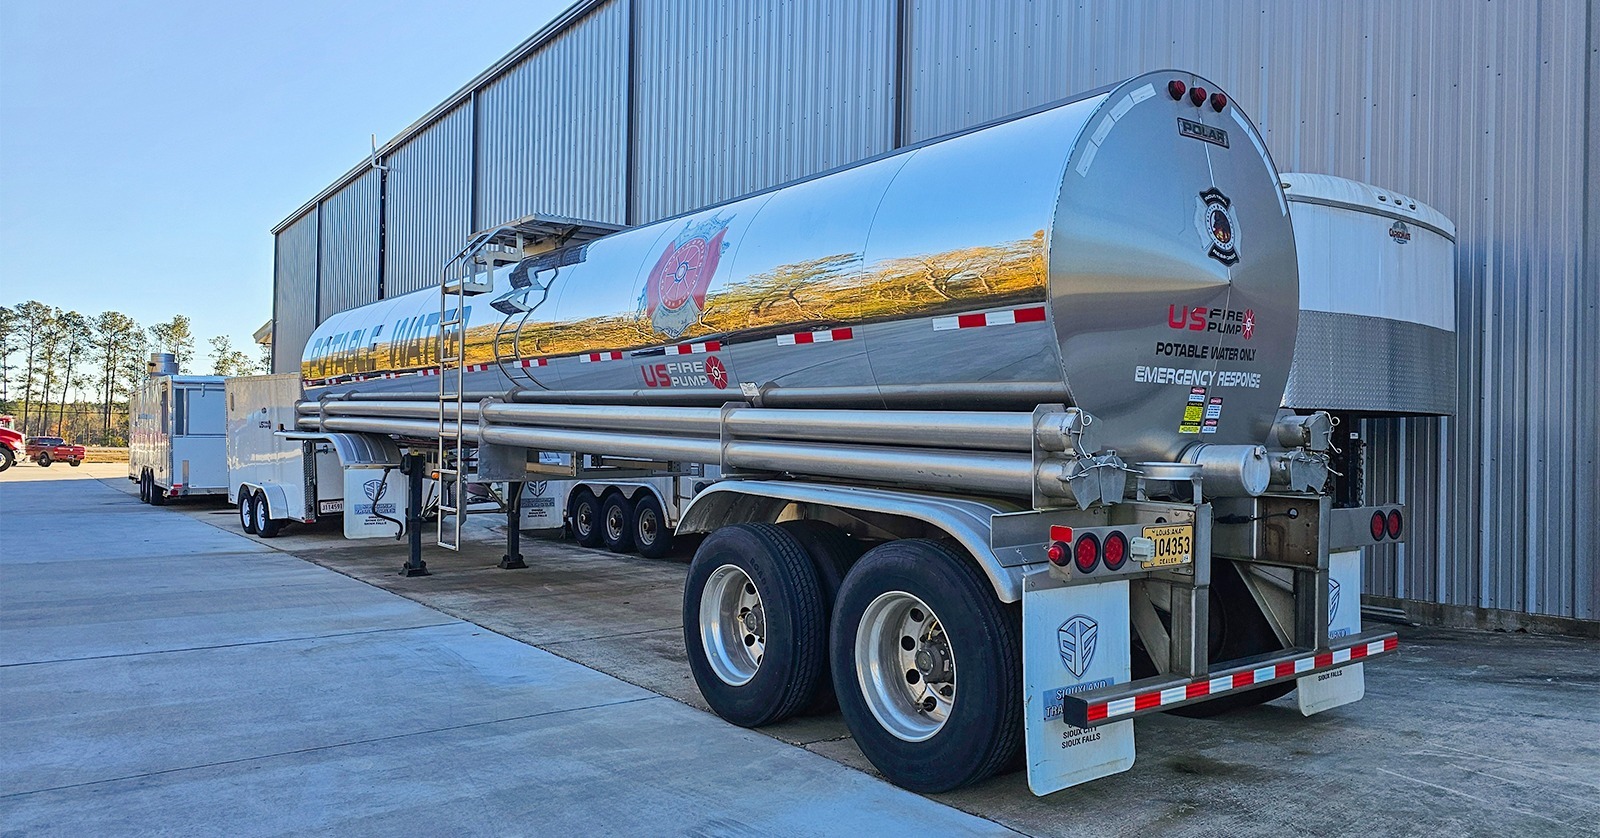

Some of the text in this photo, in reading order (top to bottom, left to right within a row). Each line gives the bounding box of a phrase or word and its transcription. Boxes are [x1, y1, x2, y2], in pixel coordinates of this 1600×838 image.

[1183, 121, 1225, 143] POLAR
[1167, 304, 1243, 332] US FIRE
[1207, 322, 1242, 335] PUMP
[1155, 341, 1257, 362] POTABLE WATER ONLY
[641, 361, 705, 388] US FIRE
[671, 375, 708, 387] PUMP
[1134, 365, 1262, 389] EMERGENCY RESPONSE
[1147, 536, 1190, 558] 104353
[1061, 732, 1101, 750] SIOUX FALLS
[1062, 728, 1082, 740] SIOUX
